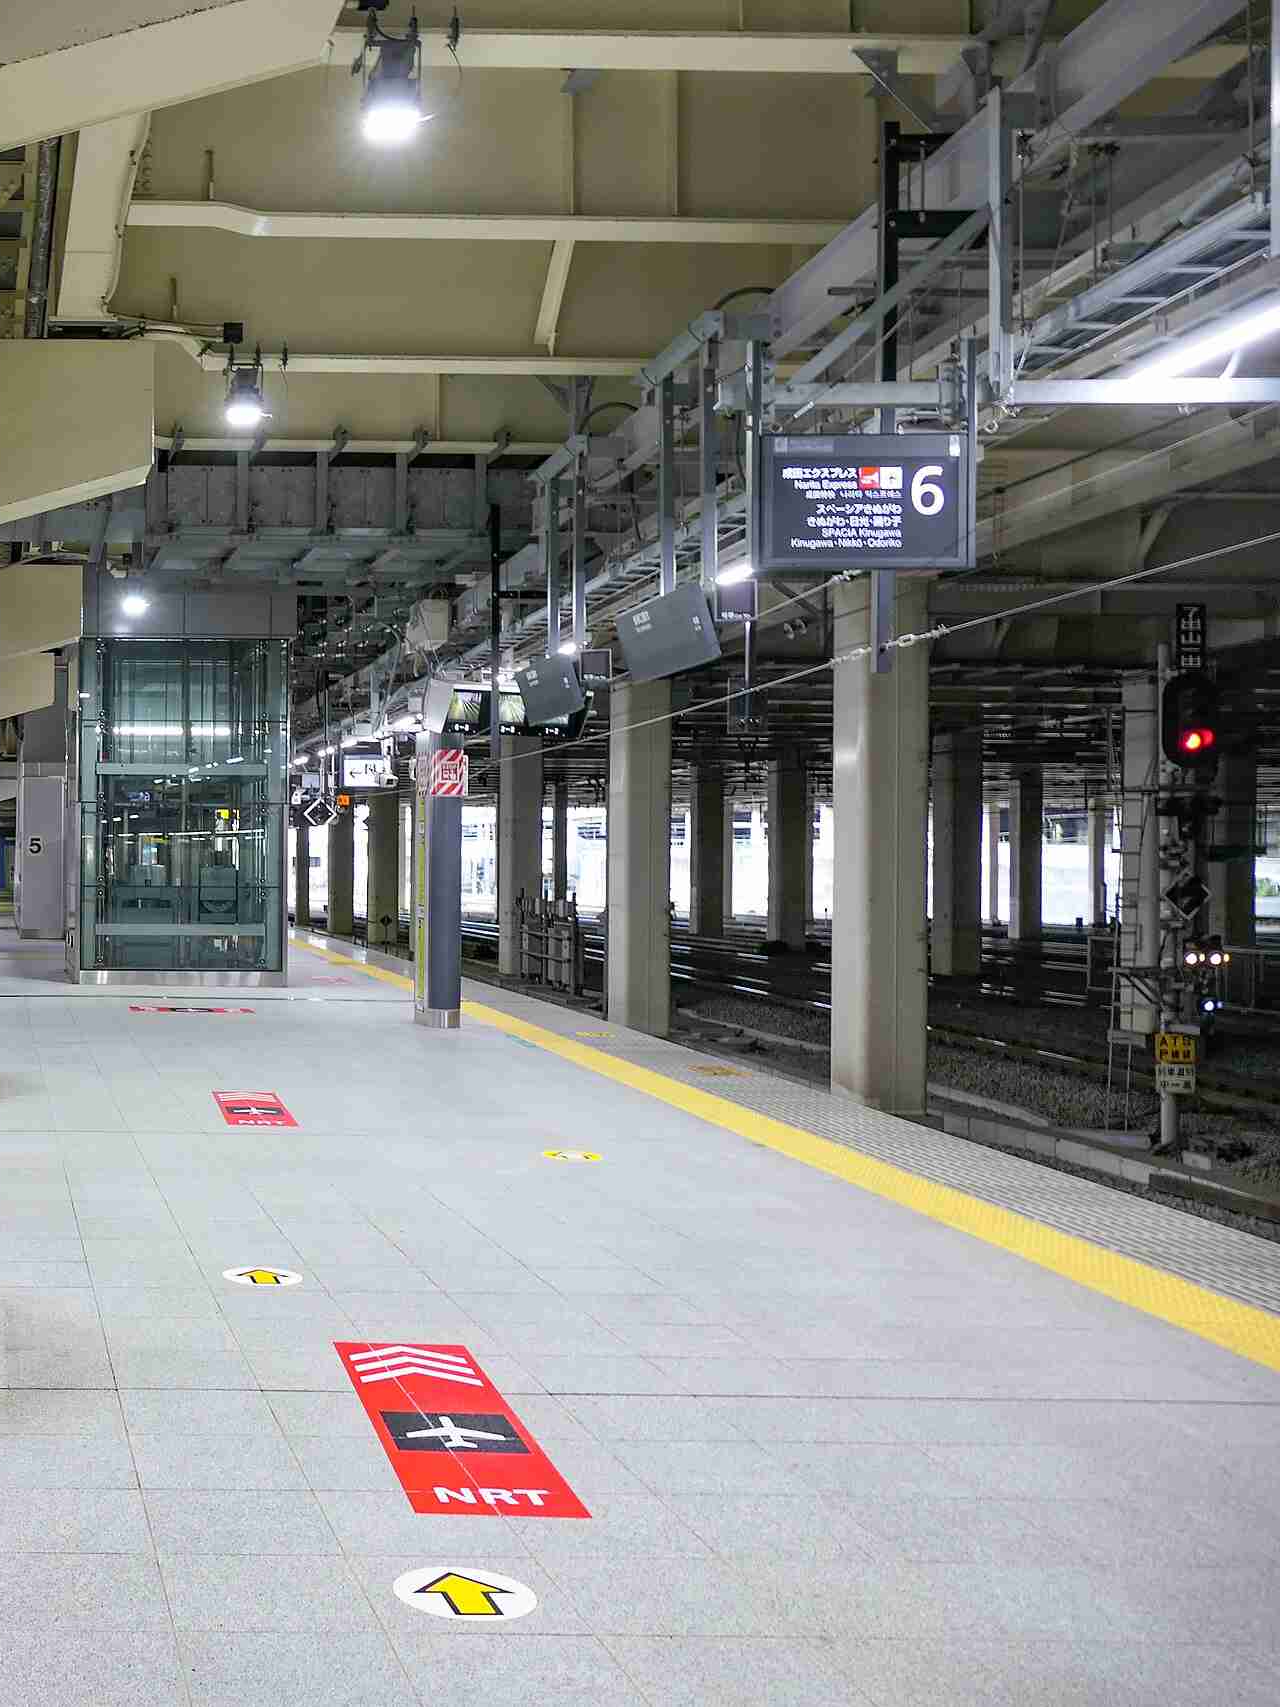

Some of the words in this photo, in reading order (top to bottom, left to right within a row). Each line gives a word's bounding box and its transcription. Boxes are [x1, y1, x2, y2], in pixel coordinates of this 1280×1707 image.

[911, 465, 945, 515] 6
[821, 527, 858, 538] SPACIA
[858, 528, 902, 539] Kinugawa
[28, 837, 42, 854] 5
[432, 1486, 551, 1506] NRT
